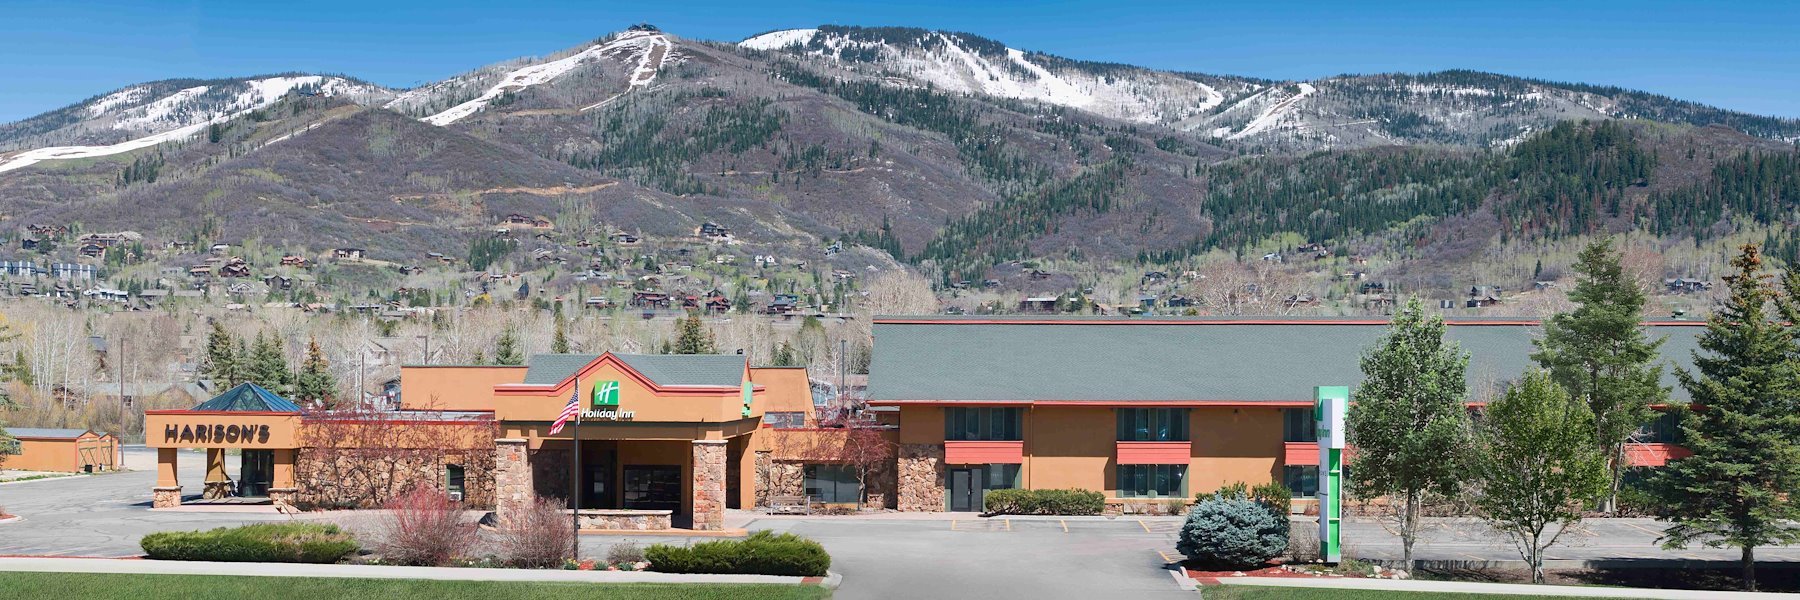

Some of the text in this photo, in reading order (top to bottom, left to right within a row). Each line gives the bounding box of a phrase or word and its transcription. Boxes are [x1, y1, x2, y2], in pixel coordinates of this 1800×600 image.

[581, 408, 634, 420] Holiday Inn
[165, 424, 270, 444] HARISON'S
